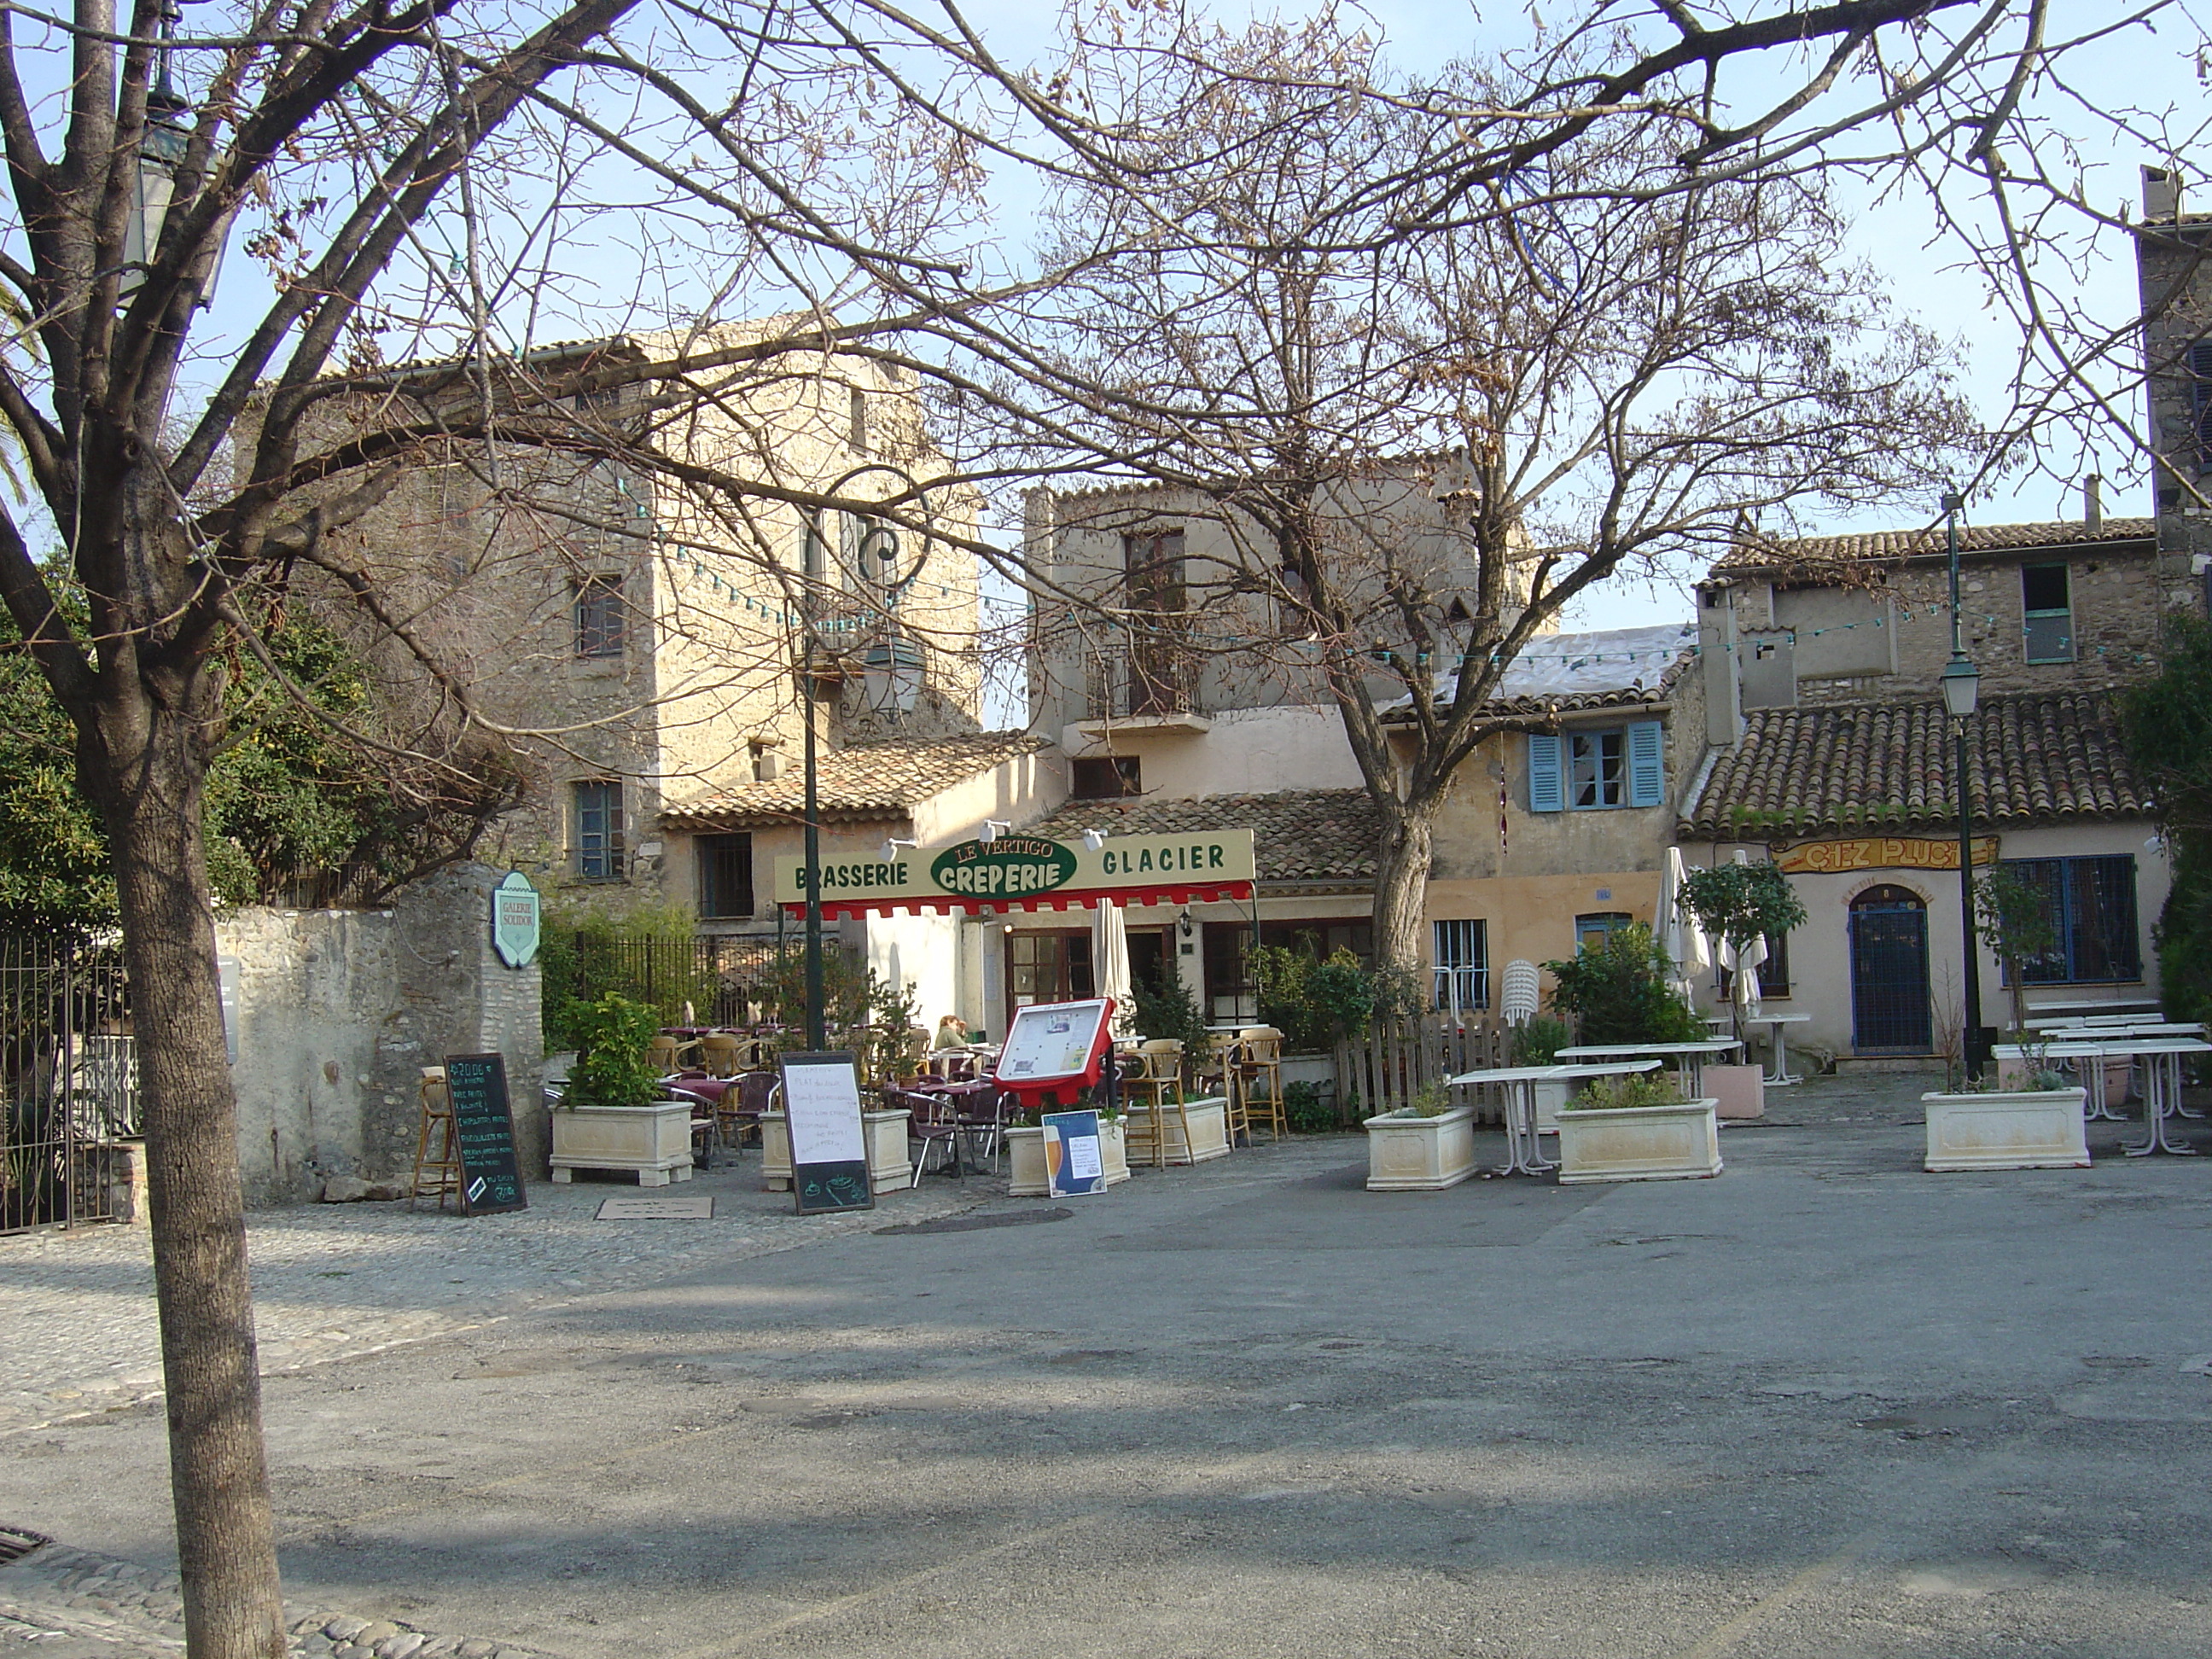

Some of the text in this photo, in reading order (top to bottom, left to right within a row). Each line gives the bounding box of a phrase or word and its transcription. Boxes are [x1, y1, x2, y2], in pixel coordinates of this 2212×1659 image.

[955, 839, 1054, 864] LE VERTIGO
[1103, 845, 1224, 875] GLACIER
[1805, 841, 1871, 868] CHEZ
[1880, 840, 1962, 867] PLUCH
[795, 862, 908, 890] BASSERIE
[940, 864, 1061, 894] CREPERIE
[1883, 889, 1889, 899] 8
[503, 902, 533, 914] GALERIE
[503, 915, 533, 927] SOLIDOR
